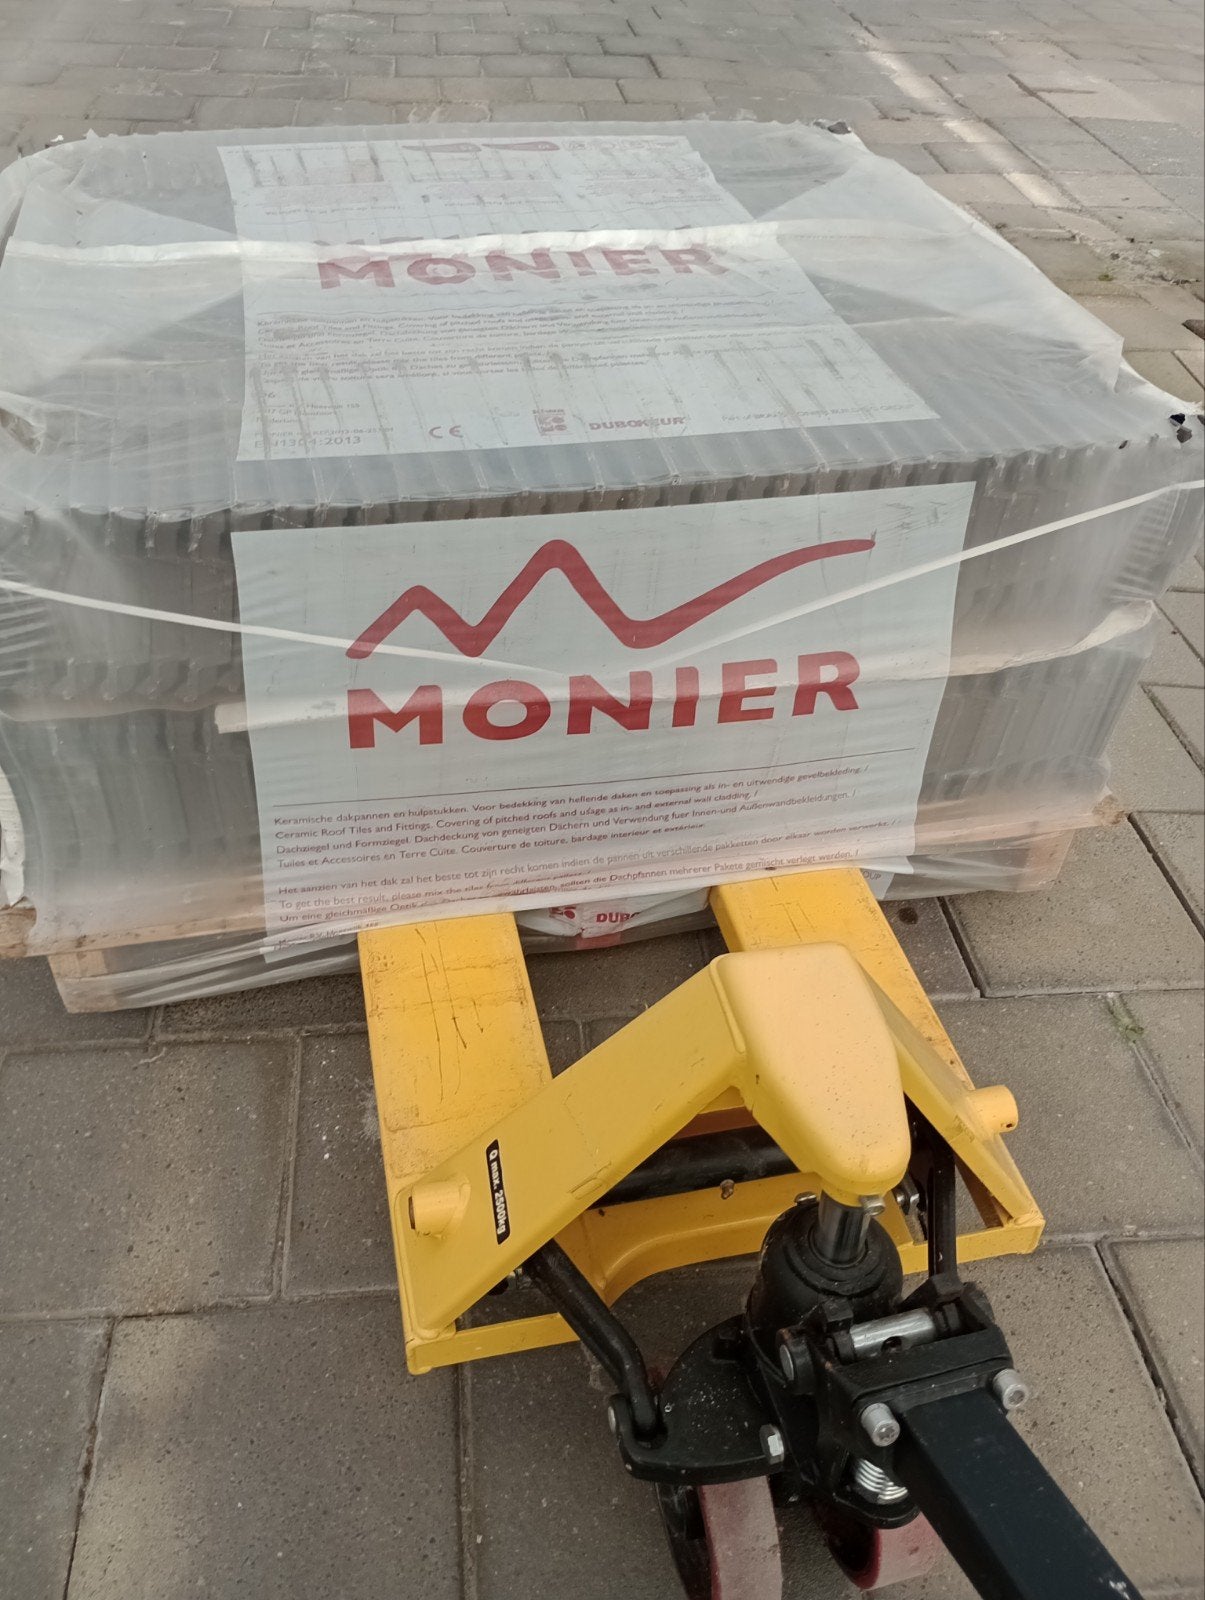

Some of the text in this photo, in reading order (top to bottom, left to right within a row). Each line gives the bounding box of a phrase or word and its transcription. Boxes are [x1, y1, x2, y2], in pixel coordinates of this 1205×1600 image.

[317, 246, 729, 289] MONIER
[347, 650, 861, 749] MONIER
[274, 816, 333, 825] Keramische
[336, 812, 390, 824] dakpannen
[408, 807, 469, 817] hulpstukken.
[472, 804, 496, 812] Voor
[499, 800, 547, 810] bedekking
[568, 794, 608, 804] hellende
[611, 791, 638, 800] daken
[655, 785, 701, 796] toepassing
[747, 775, 795, 787] uitwendige
[275, 830, 318, 840] Ceramic
[321, 826, 346, 837] Roof
[350, 825, 372, 834] Tiles
[375, 824, 393, 833] and
[395, 822, 433, 832] Fittings.
[436, 819, 481, 829] Covering
[483, 815, 493, 824] of
[495, 813, 530, 825] pitched
[532, 811, 557, 820] roofs
[560, 809, 577, 818] and
[580, 806, 606, 816] usage
[635, 803, 652, 811] and
[654, 798, 691, 808] external
[694, 795, 711, 803] wall
[277, 843, 330, 854] Dachziegel
[333, 841, 352, 849] und
[415, 833, 479, 843] Dachdeckung
[502, 825, 546, 838] geneigten
[593, 818, 610, 827] und
[613, 813, 670, 825] Verwendung
[672, 810, 690, 820] fuer
[279, 858, 306, 868] Tuiles
[308, 858, 319, 866] et
[321, 855, 381, 865] Accessoires
[384, 853, 396, 861] en
[400, 850, 427, 859] Terre
[461, 842, 517, 854] Couverture
[571, 834, 608, 844] bardage
[278, 887, 298, 895] Het
[301, 884, 338, 893] aanzien
[380, 878, 399, 886] dak
[400, 876, 413, 884] zal
[416, 874, 433, 883] het
[435, 872, 462, 882] beste
[464, 870, 479, 878] tot
[481, 868, 497, 879] zijn
[500, 865, 525, 875] recht
[527, 861, 559, 871] komen
[561, 858, 590, 868] indien
[593, 856, 605, 864] de
[607, 852, 640, 865] pannen
[642, 850, 655, 859] uit
[656, 843, 714, 857] verschillende
[301, 912, 322, 921] eine
[609, 869, 668, 881] Dachpfannen
[669, 865, 712, 875] mehrerer
[714, 861, 743, 871] Pakete
[786, 855, 816, 865] verlegt
[862, 870, 882, 880] OUP
[280, 900, 292, 909] To
[296, 898, 312, 910] get
[314, 896, 330, 905] the
[333, 894, 357, 904] best
[391, 890, 422, 901] please
[424, 889, 442, 897] mix
[489, 1149, 506, 1235] Q max. 2500kg
